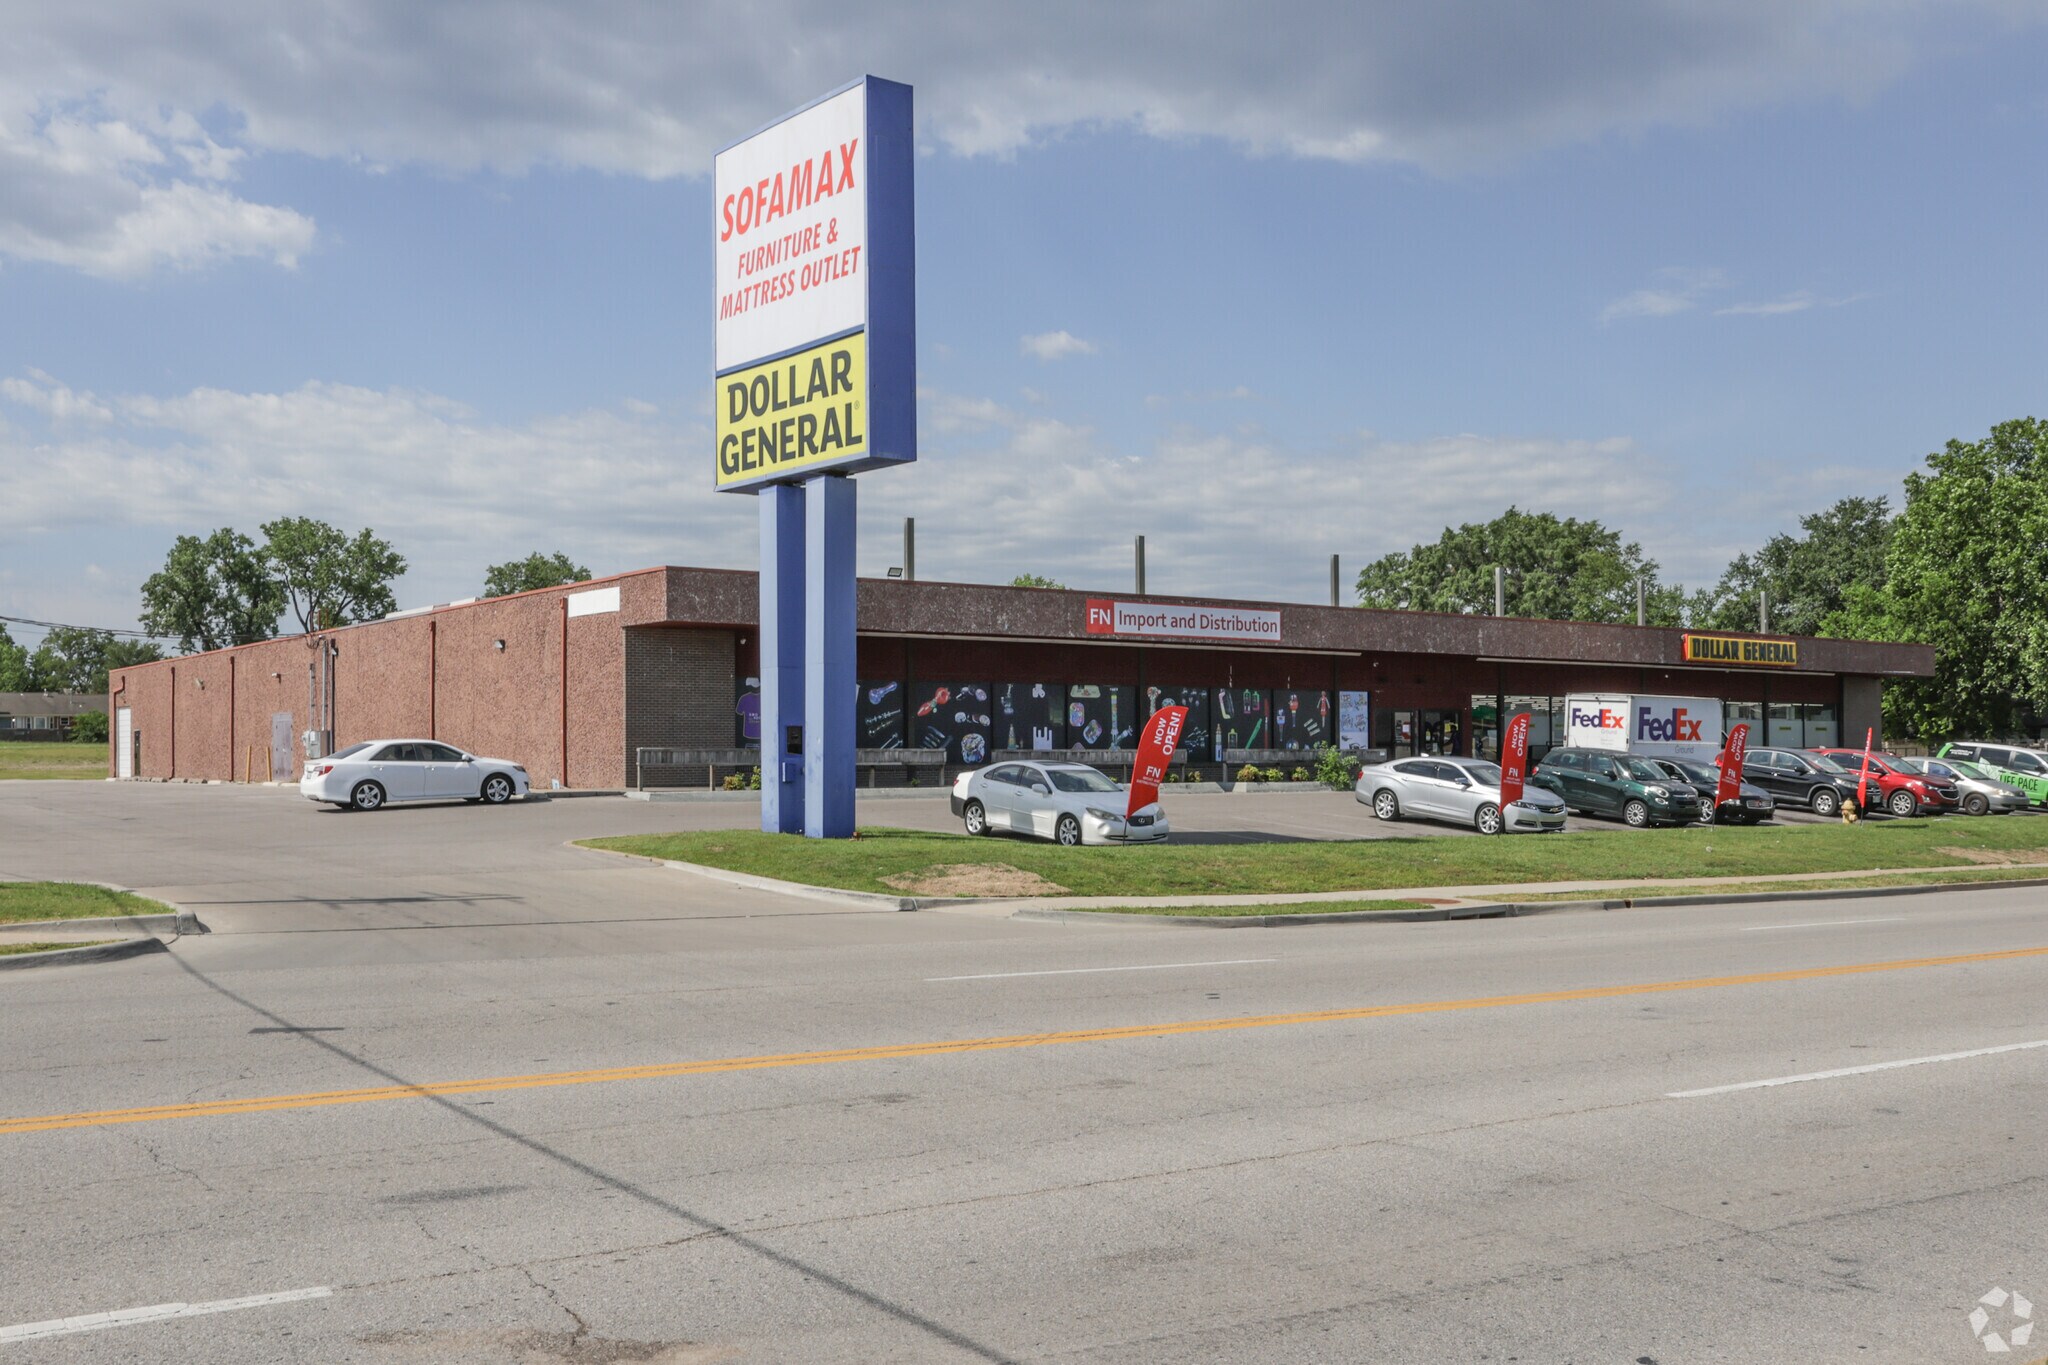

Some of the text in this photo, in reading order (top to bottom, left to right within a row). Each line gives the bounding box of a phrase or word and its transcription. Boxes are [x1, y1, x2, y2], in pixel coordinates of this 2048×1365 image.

[721, 138, 858, 242] SOFAMAX
[738, 217, 838, 279] FURNITURE &
[720, 245, 861, 321] MATTRESS OUTLET
[728, 349, 853, 424] DOLLAR
[720, 402, 863, 476] GENERAL
[1089, 608, 1111, 625] FN
[1119, 610, 1277, 633] Import and Distribution
[1692, 638, 1795, 662] DOLLAR GENERAL
[1153, 717, 1167, 745] NOW
[1572, 708, 1624, 729] FedEx
[1638, 707, 1702, 741] FedEx
[1162, 711, 1181, 755] OPEN!
[1511, 724, 1519, 748] NOW
[1517, 719, 1527, 757] OPEN!
[1674, 744, 1695, 754] Ground
[1145, 765, 1161, 778] FN
[2018, 777, 2039, 791] PACE
